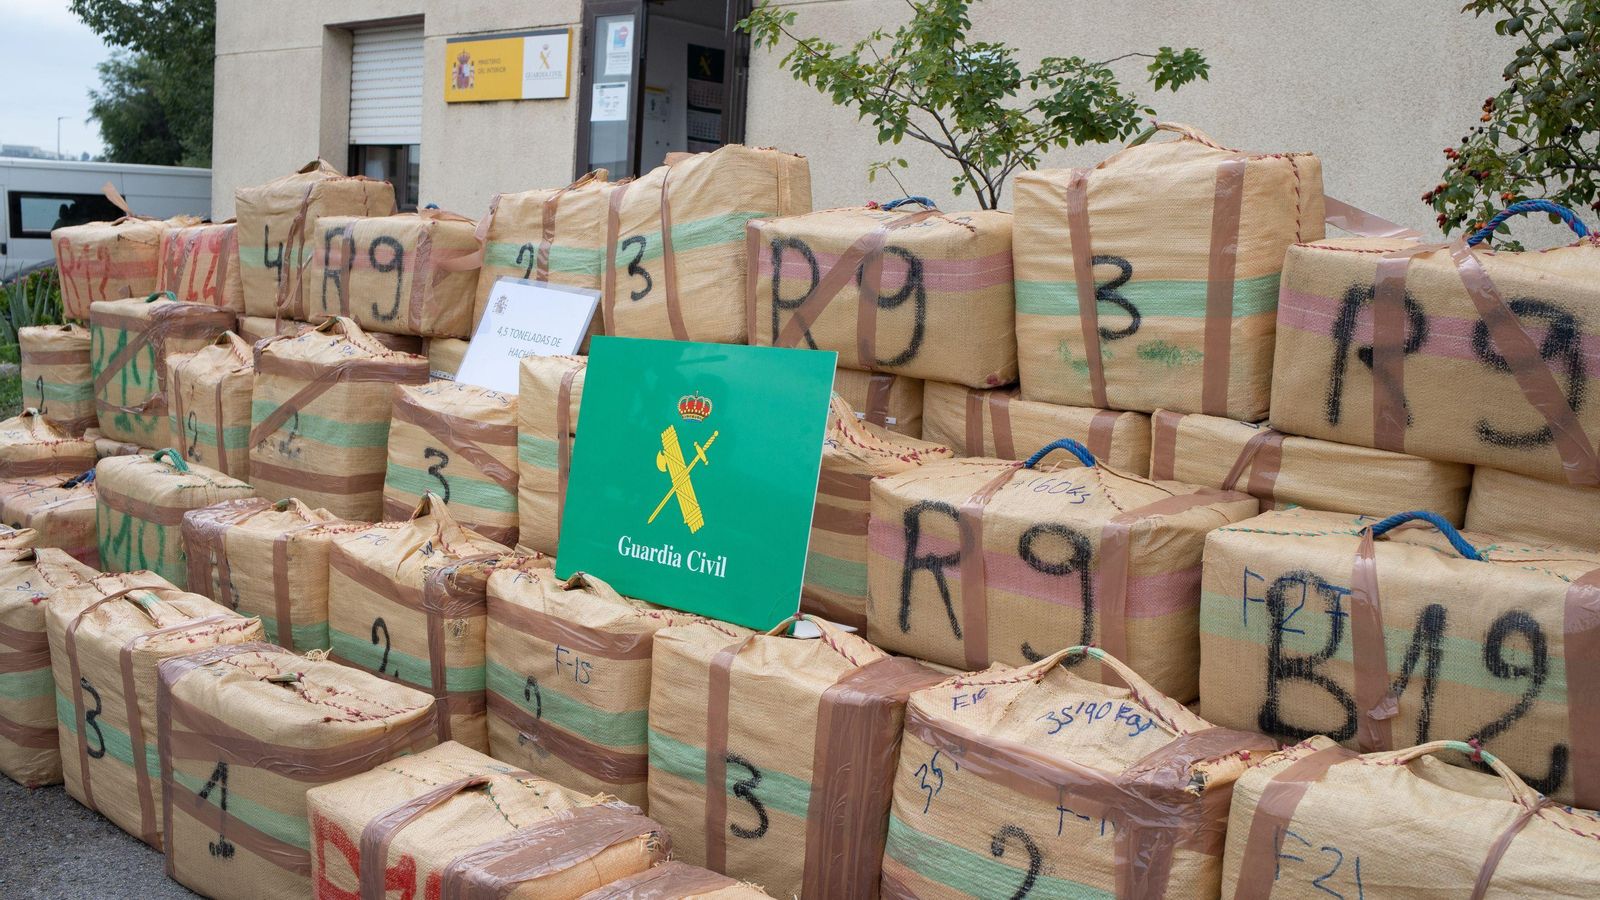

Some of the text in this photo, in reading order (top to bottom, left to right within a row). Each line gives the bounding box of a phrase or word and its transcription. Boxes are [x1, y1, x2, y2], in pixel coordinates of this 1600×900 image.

[621, 234, 654, 303] 3
[1090, 254, 1142, 342] 3
[497, 326, 563, 348] 4,5 TONELADAS DE
[618, 535, 727, 578] Guardia Civil
[80, 676, 107, 760] 3
[724, 750, 770, 840] 3
